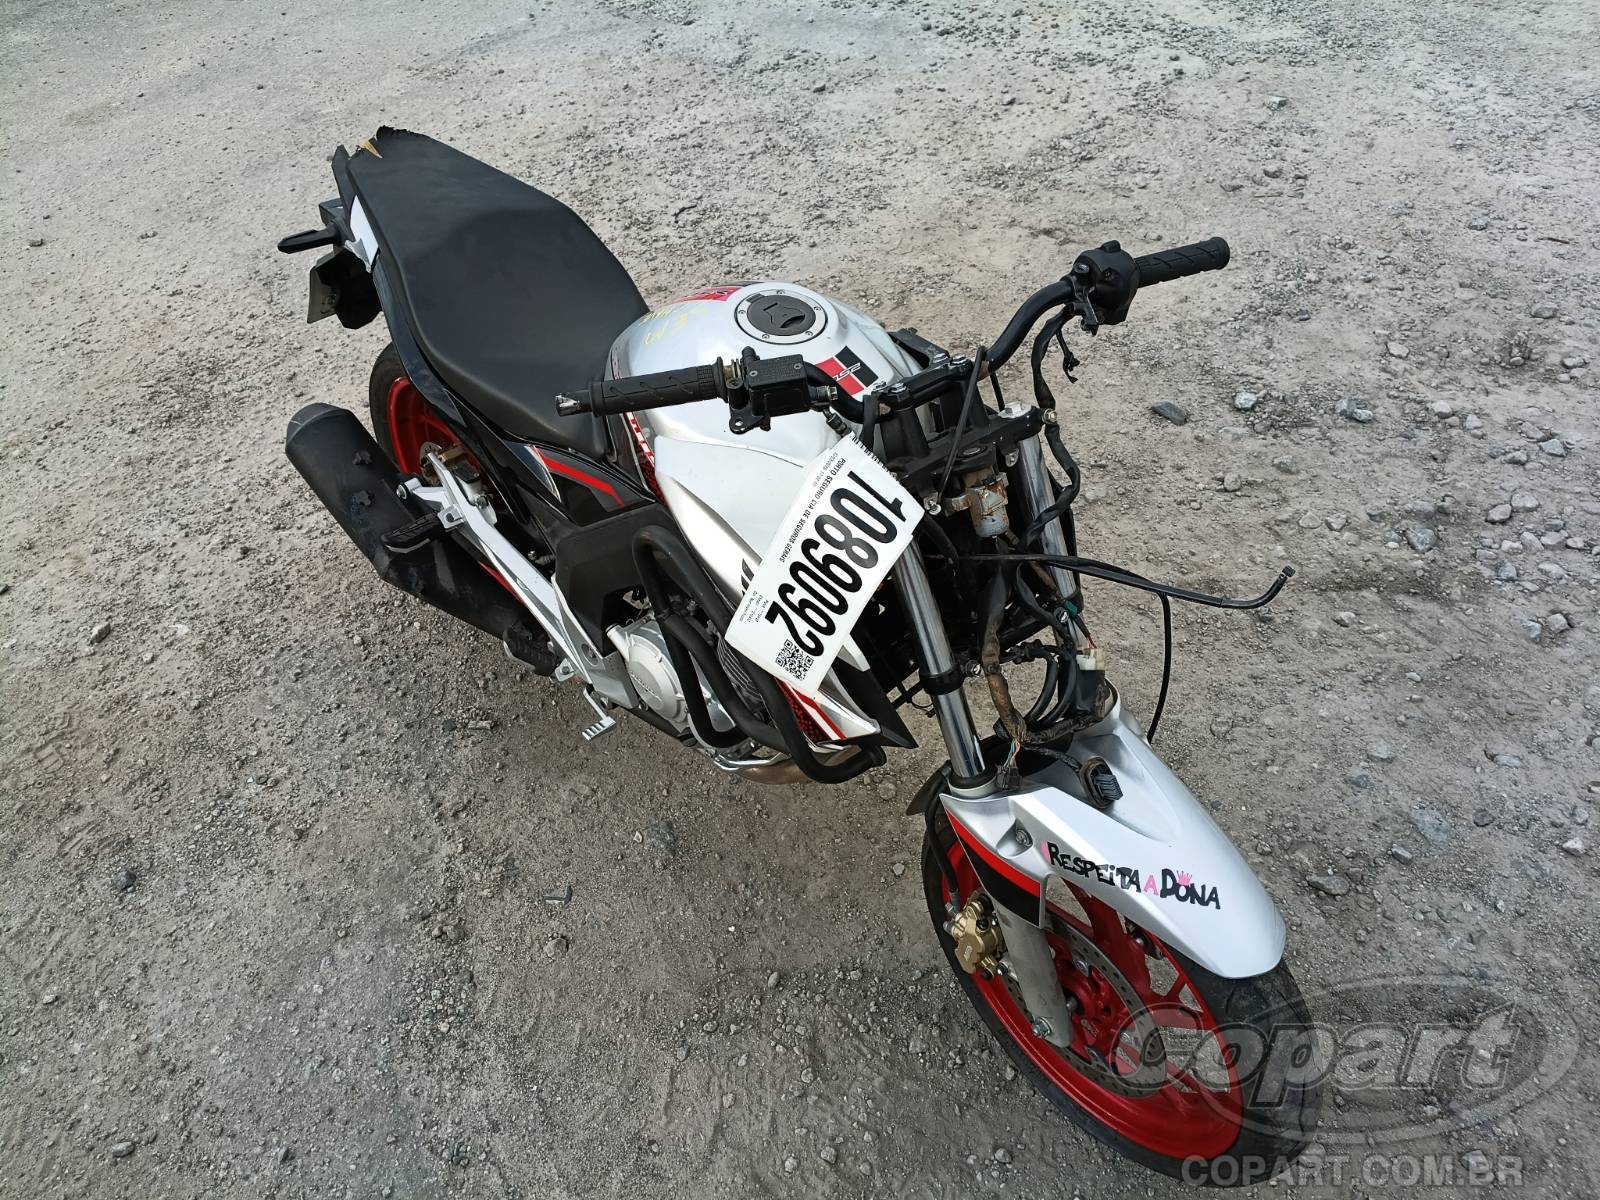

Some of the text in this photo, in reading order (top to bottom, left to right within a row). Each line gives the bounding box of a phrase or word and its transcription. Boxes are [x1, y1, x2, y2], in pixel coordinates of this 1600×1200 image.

[830, 457, 847, 476] PORTO
[814, 475, 833, 500] SEGURO
[803, 509, 812, 519] DE
[808, 499, 817, 510] CIA
[789, 518, 807, 544] SEGUROS
[764, 470, 907, 657] 1089092
[779, 543, 793, 563] GERAIS
[1143, 874, 1159, 896] A
[1160, 868, 1222, 910] DONA
